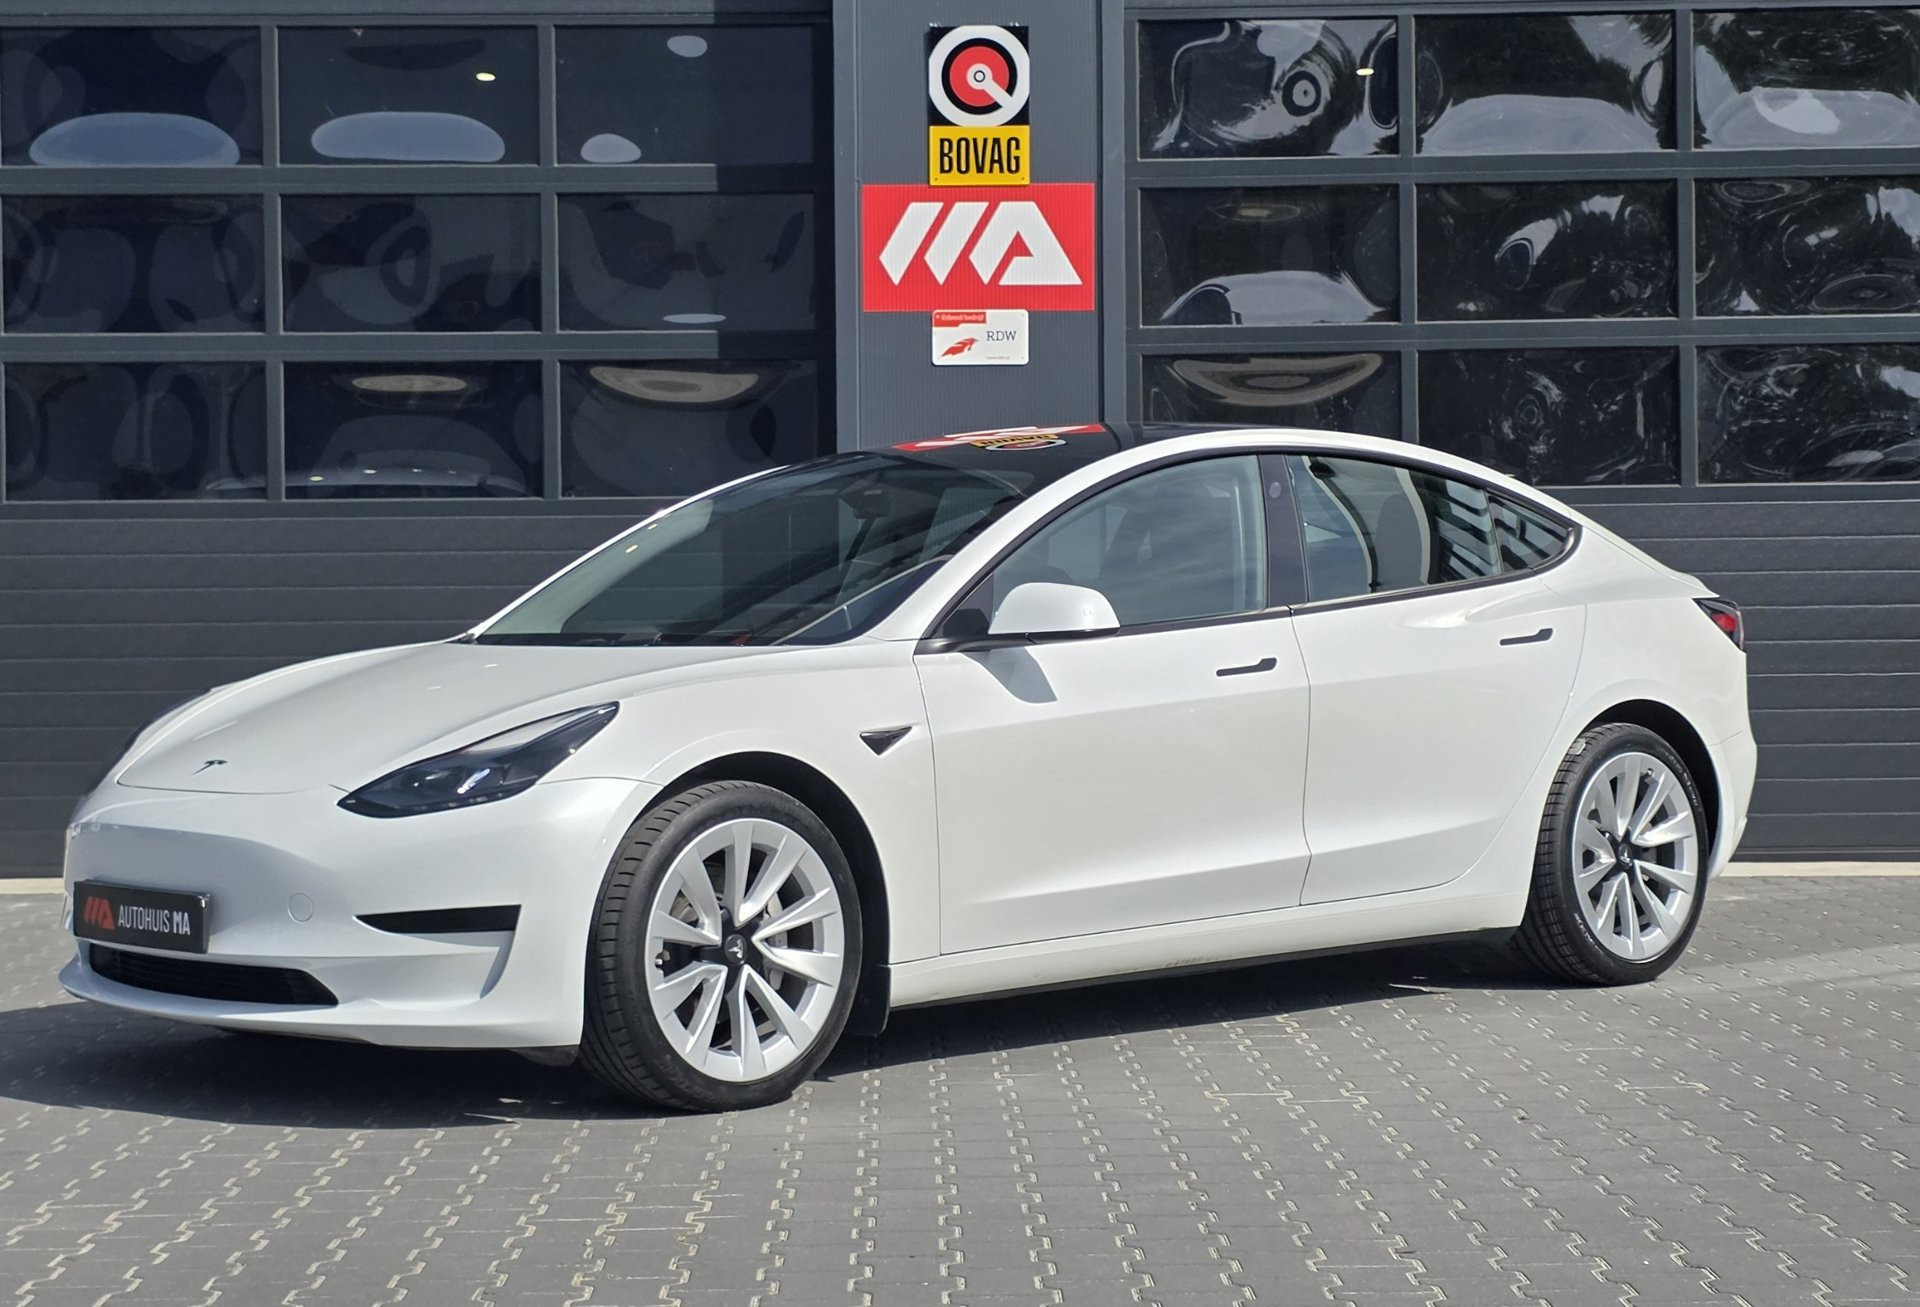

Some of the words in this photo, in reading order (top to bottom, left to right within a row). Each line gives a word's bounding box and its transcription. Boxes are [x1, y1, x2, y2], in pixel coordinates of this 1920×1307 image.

[939, 137, 1020, 175] BOVAG
[986, 331, 1017, 341] RDW
[118, 904, 170, 933] AUTOHUIS
[172, 911, 191, 936] MA
